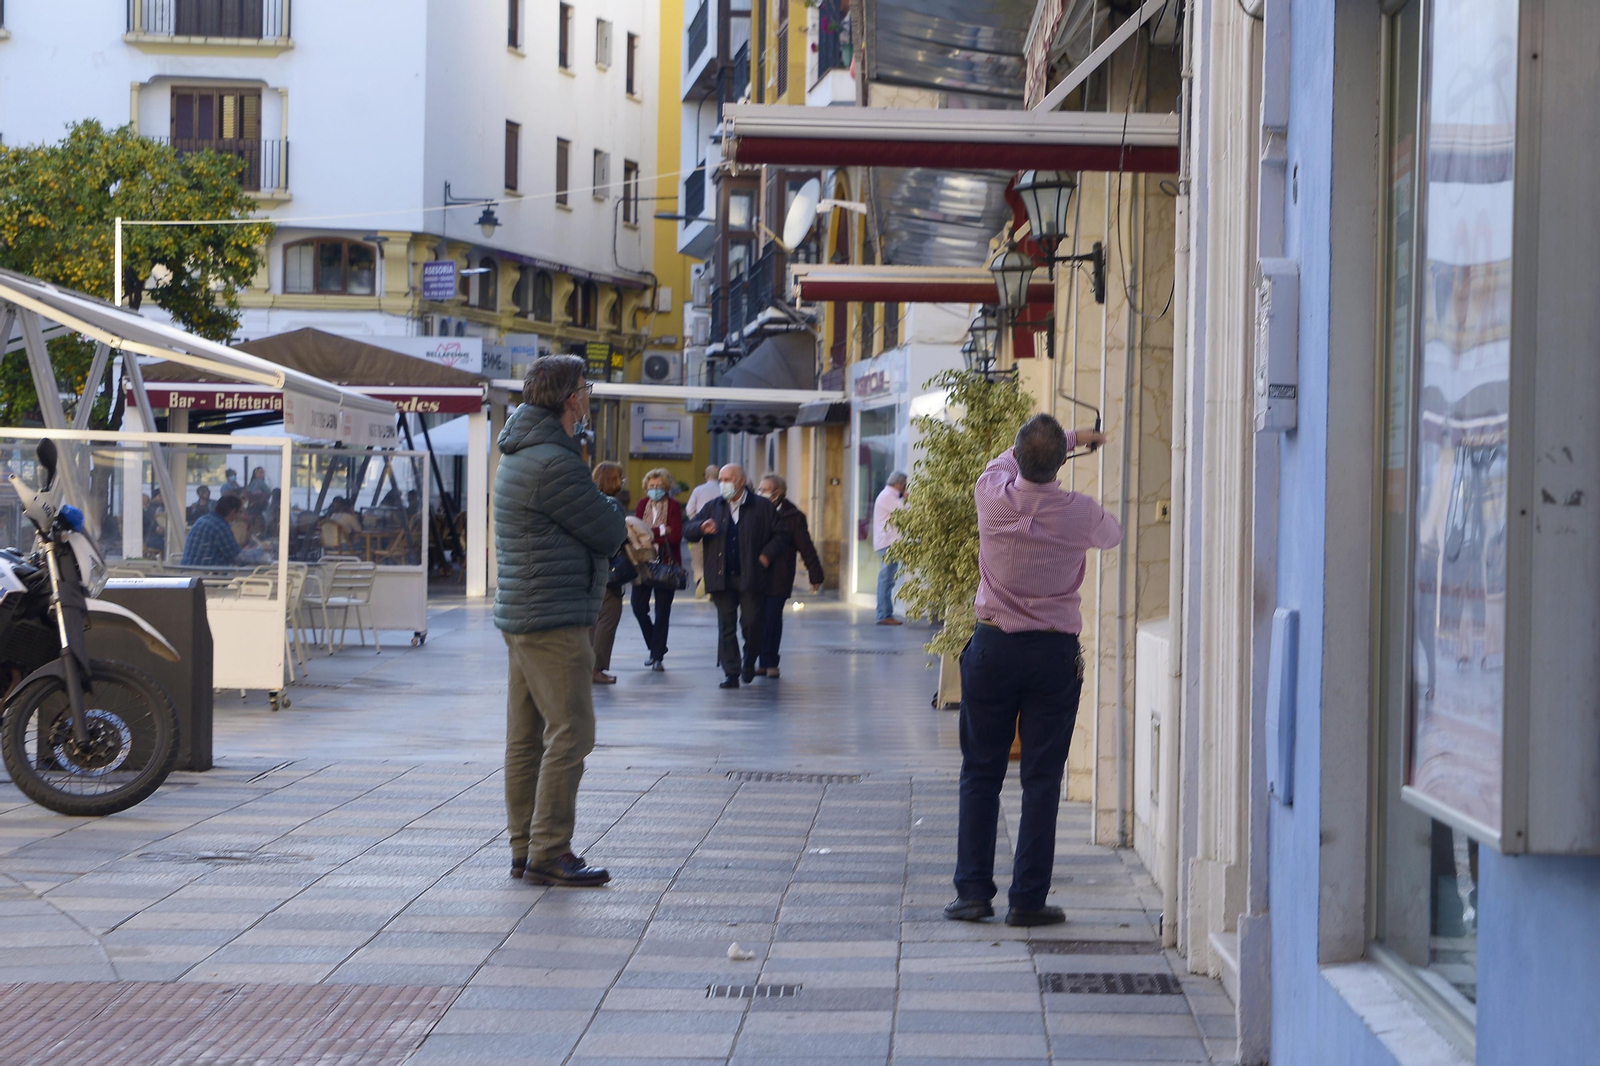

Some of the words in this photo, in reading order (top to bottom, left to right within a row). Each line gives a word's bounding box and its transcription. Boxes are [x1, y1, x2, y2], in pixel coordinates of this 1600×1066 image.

[424, 264, 454, 276] ASESORÍA
[426, 351, 469, 359] BELLAFEMME
[483, 353, 502, 370] EMME
[169, 391, 195, 408] Bar
[215, 392, 283, 410] Cafetería
[394, 396, 440, 413] edes
